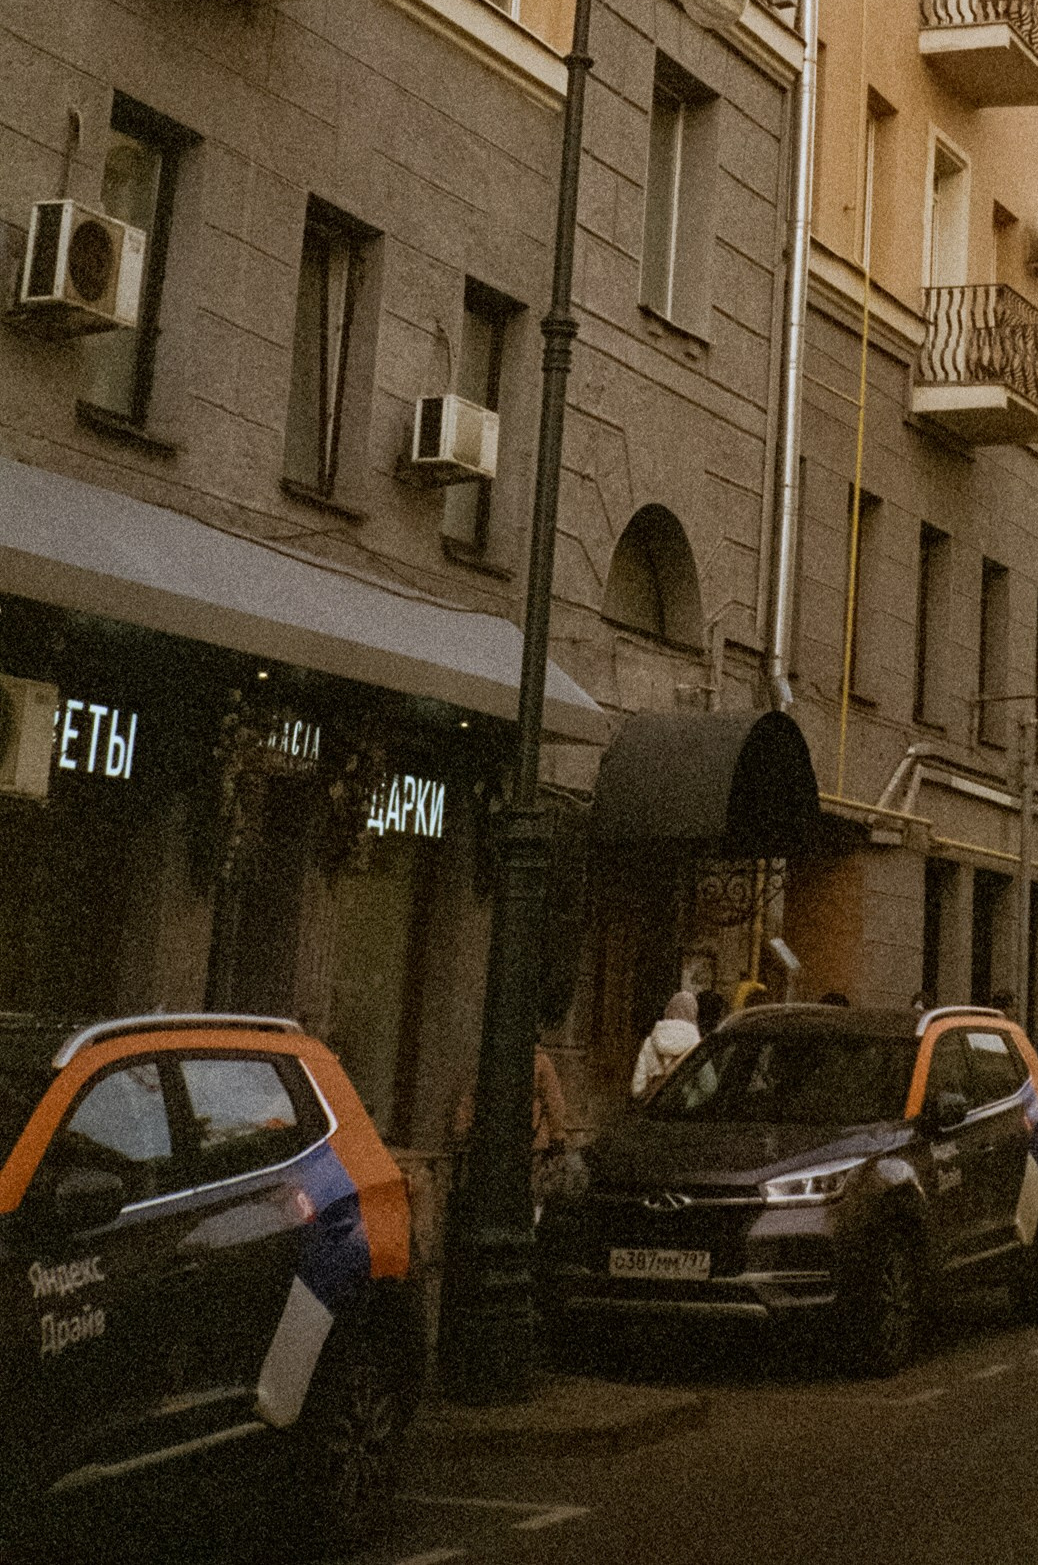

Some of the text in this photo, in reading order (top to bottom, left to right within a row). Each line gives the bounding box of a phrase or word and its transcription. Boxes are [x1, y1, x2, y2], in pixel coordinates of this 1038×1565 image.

[53, 699, 138, 779] ЕТЫ
[28, 1256, 105, 1298] Яндекс
[40, 1304, 106, 1359] Драйв
